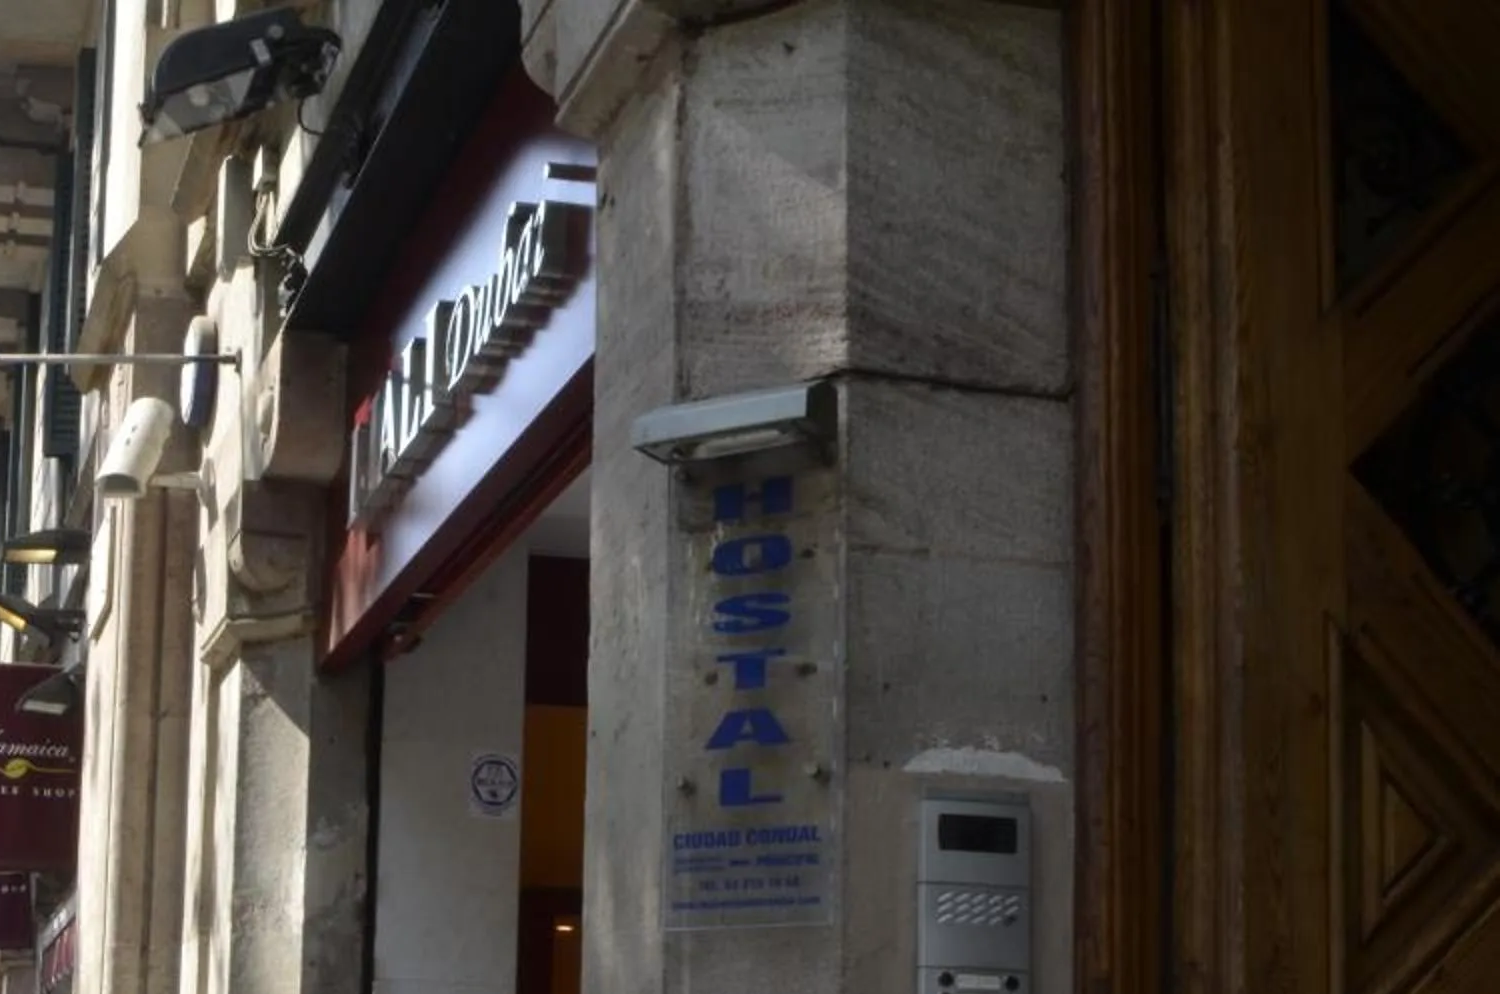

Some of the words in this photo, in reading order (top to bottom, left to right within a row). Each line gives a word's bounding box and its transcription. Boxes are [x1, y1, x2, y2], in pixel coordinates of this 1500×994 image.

[445, 162, 550, 392] Dubai
[705, 475, 794, 807] HOSTAL
[32, 786, 77, 799] SHOP
[673, 829, 742, 850] CIUDAD
[745, 824, 823, 845] CONDAL
